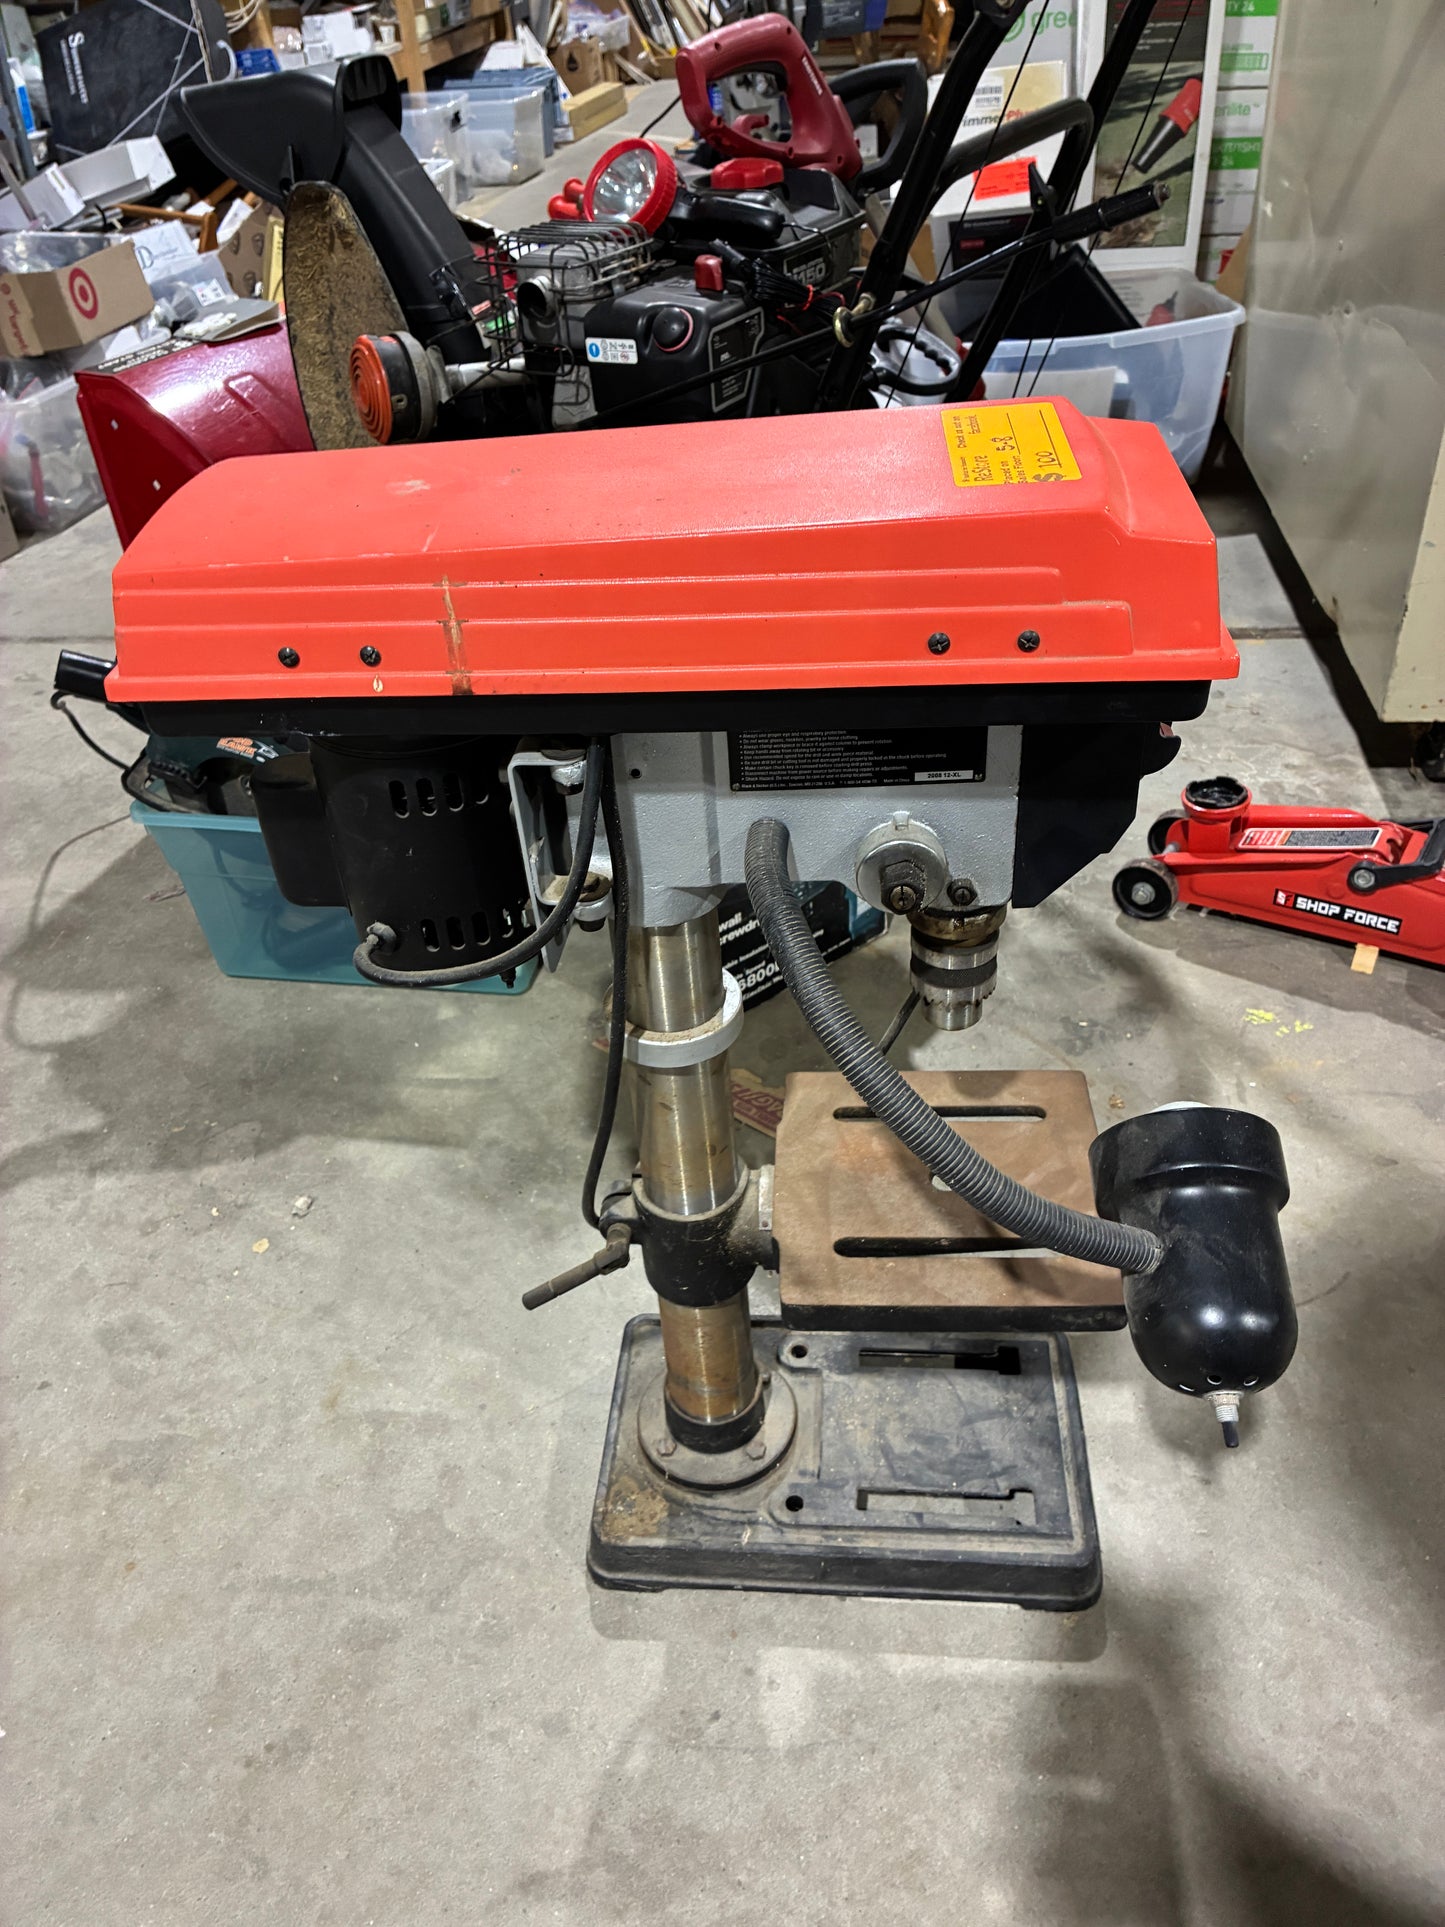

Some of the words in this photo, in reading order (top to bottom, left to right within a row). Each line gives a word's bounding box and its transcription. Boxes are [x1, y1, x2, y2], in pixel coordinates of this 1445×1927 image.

[972, 455, 993, 481] ReStore
[1035, 451, 1061, 468] 100
[1296, 896, 1340, 916] SHOP
[1343, 907, 1400, 933] FORCE
